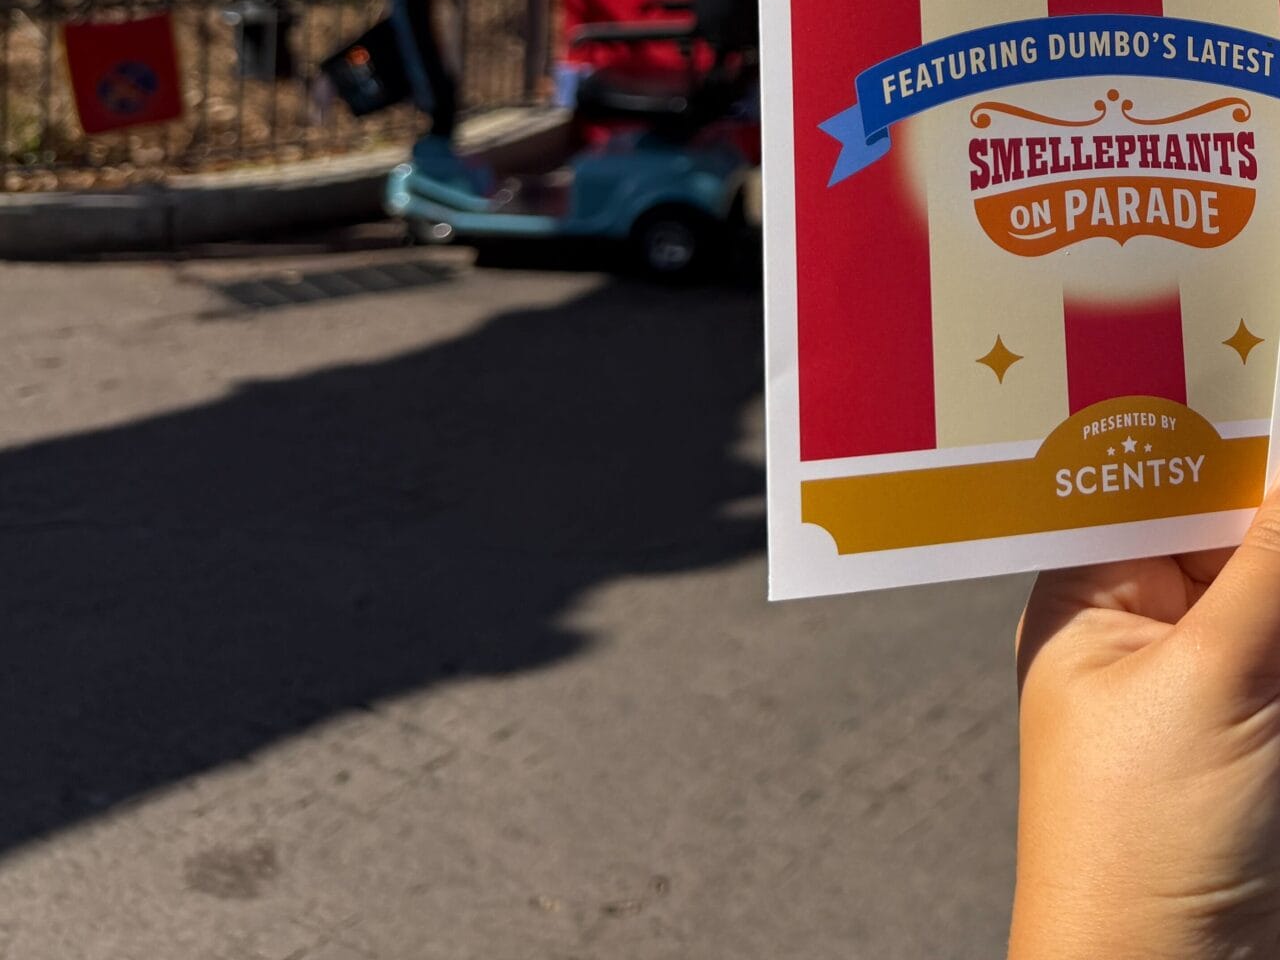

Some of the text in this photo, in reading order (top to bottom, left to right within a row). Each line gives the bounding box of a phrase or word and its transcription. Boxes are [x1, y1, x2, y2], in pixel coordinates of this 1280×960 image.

[882, 36, 1038, 105] FEATURING
[1048, 30, 1177, 62] DUMBO’S
[968, 131, 1258, 191] SMELLEPHANTS
[1010, 186, 1220, 234] ON PARADE
[1083, 412, 1177, 440] PRESENTED BY
[1055, 454, 1205, 498] SCENTSY
